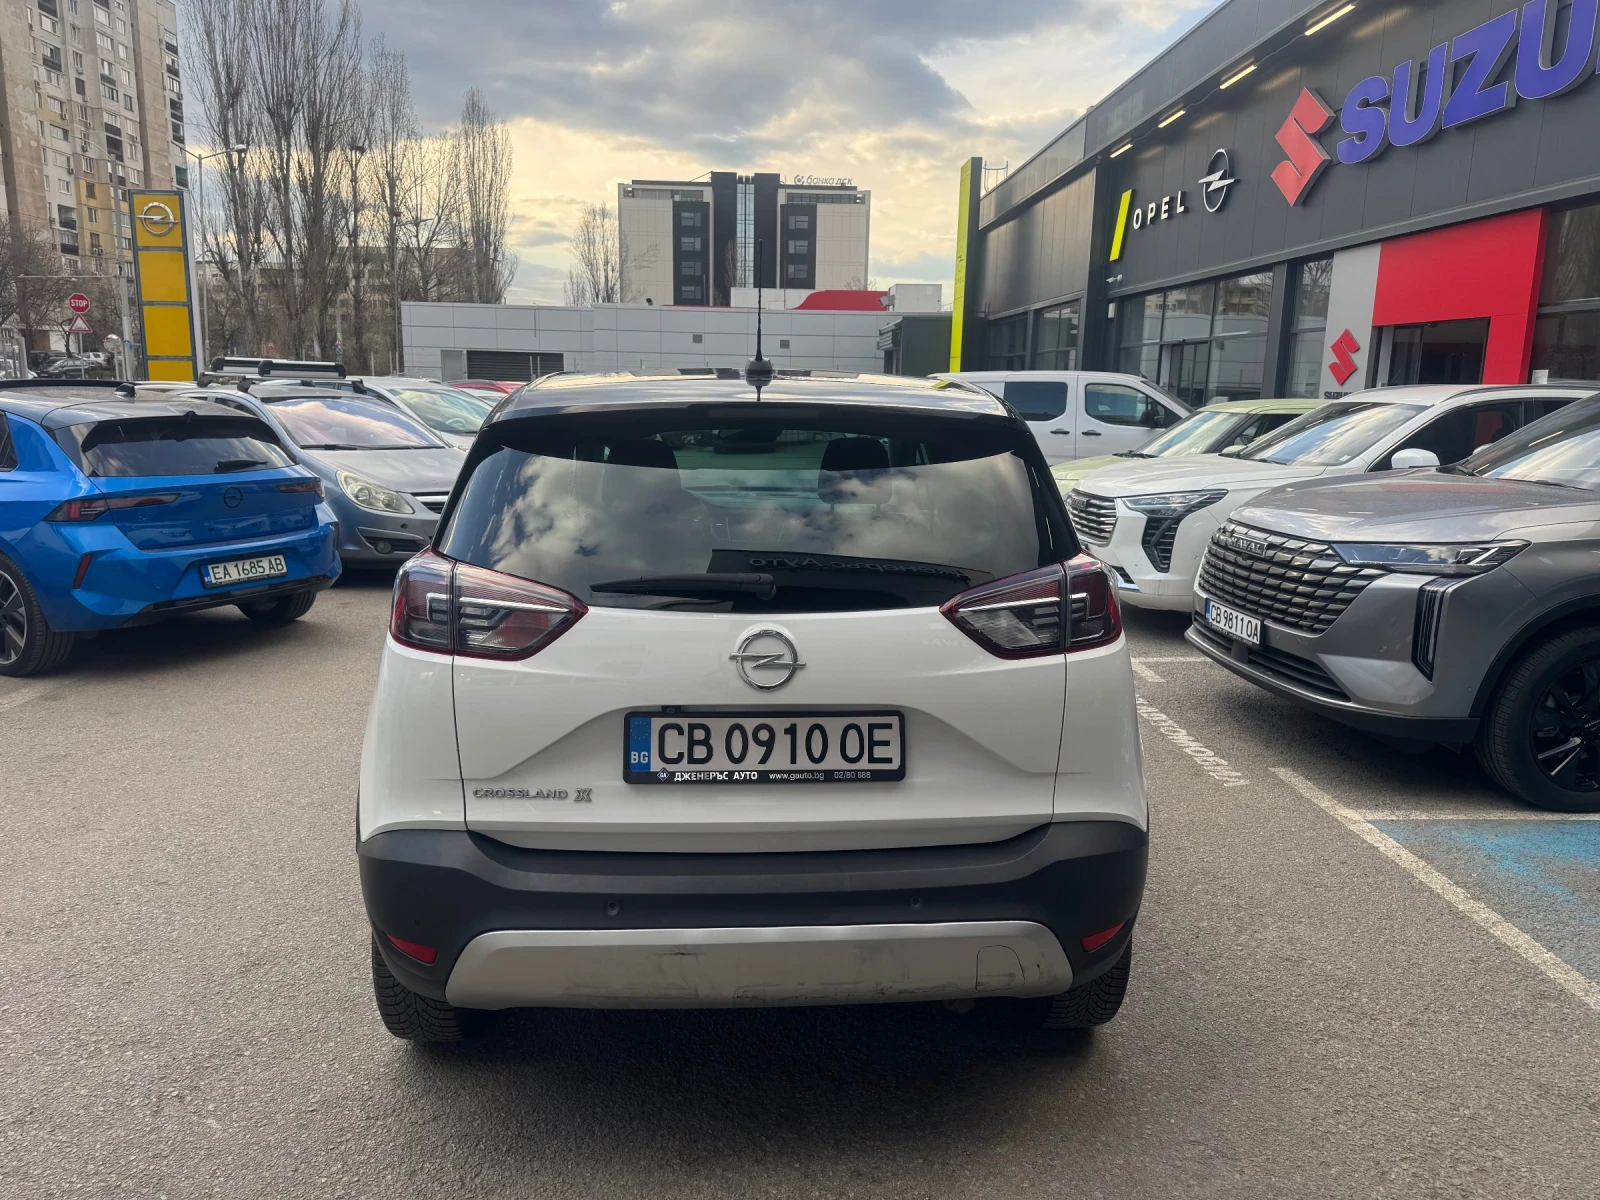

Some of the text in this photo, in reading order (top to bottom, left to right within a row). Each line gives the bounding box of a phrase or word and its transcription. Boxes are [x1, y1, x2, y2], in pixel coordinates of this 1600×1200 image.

[1337, 0, 1600, 164] SUZU
[806, 174, 835, 185] банка
[1133, 190, 1185, 230] OPEL
[71, 299, 88, 308] STOP
[211, 565, 232, 580] EA
[234, 560, 265, 577] 1685
[268, 557, 284, 573] AB
[1211, 604, 1222, 624] CB
[1223, 609, 1244, 635] 9811
[658, 722, 893, 765] CB 0910 OE
[630, 751, 649, 764] BG
[674, 771, 758, 782] ДЖЕНЕРЪС АУТО
[768, 772, 825, 781] www.gauto.bg
[472, 787, 593, 802] CROSSLAND X
